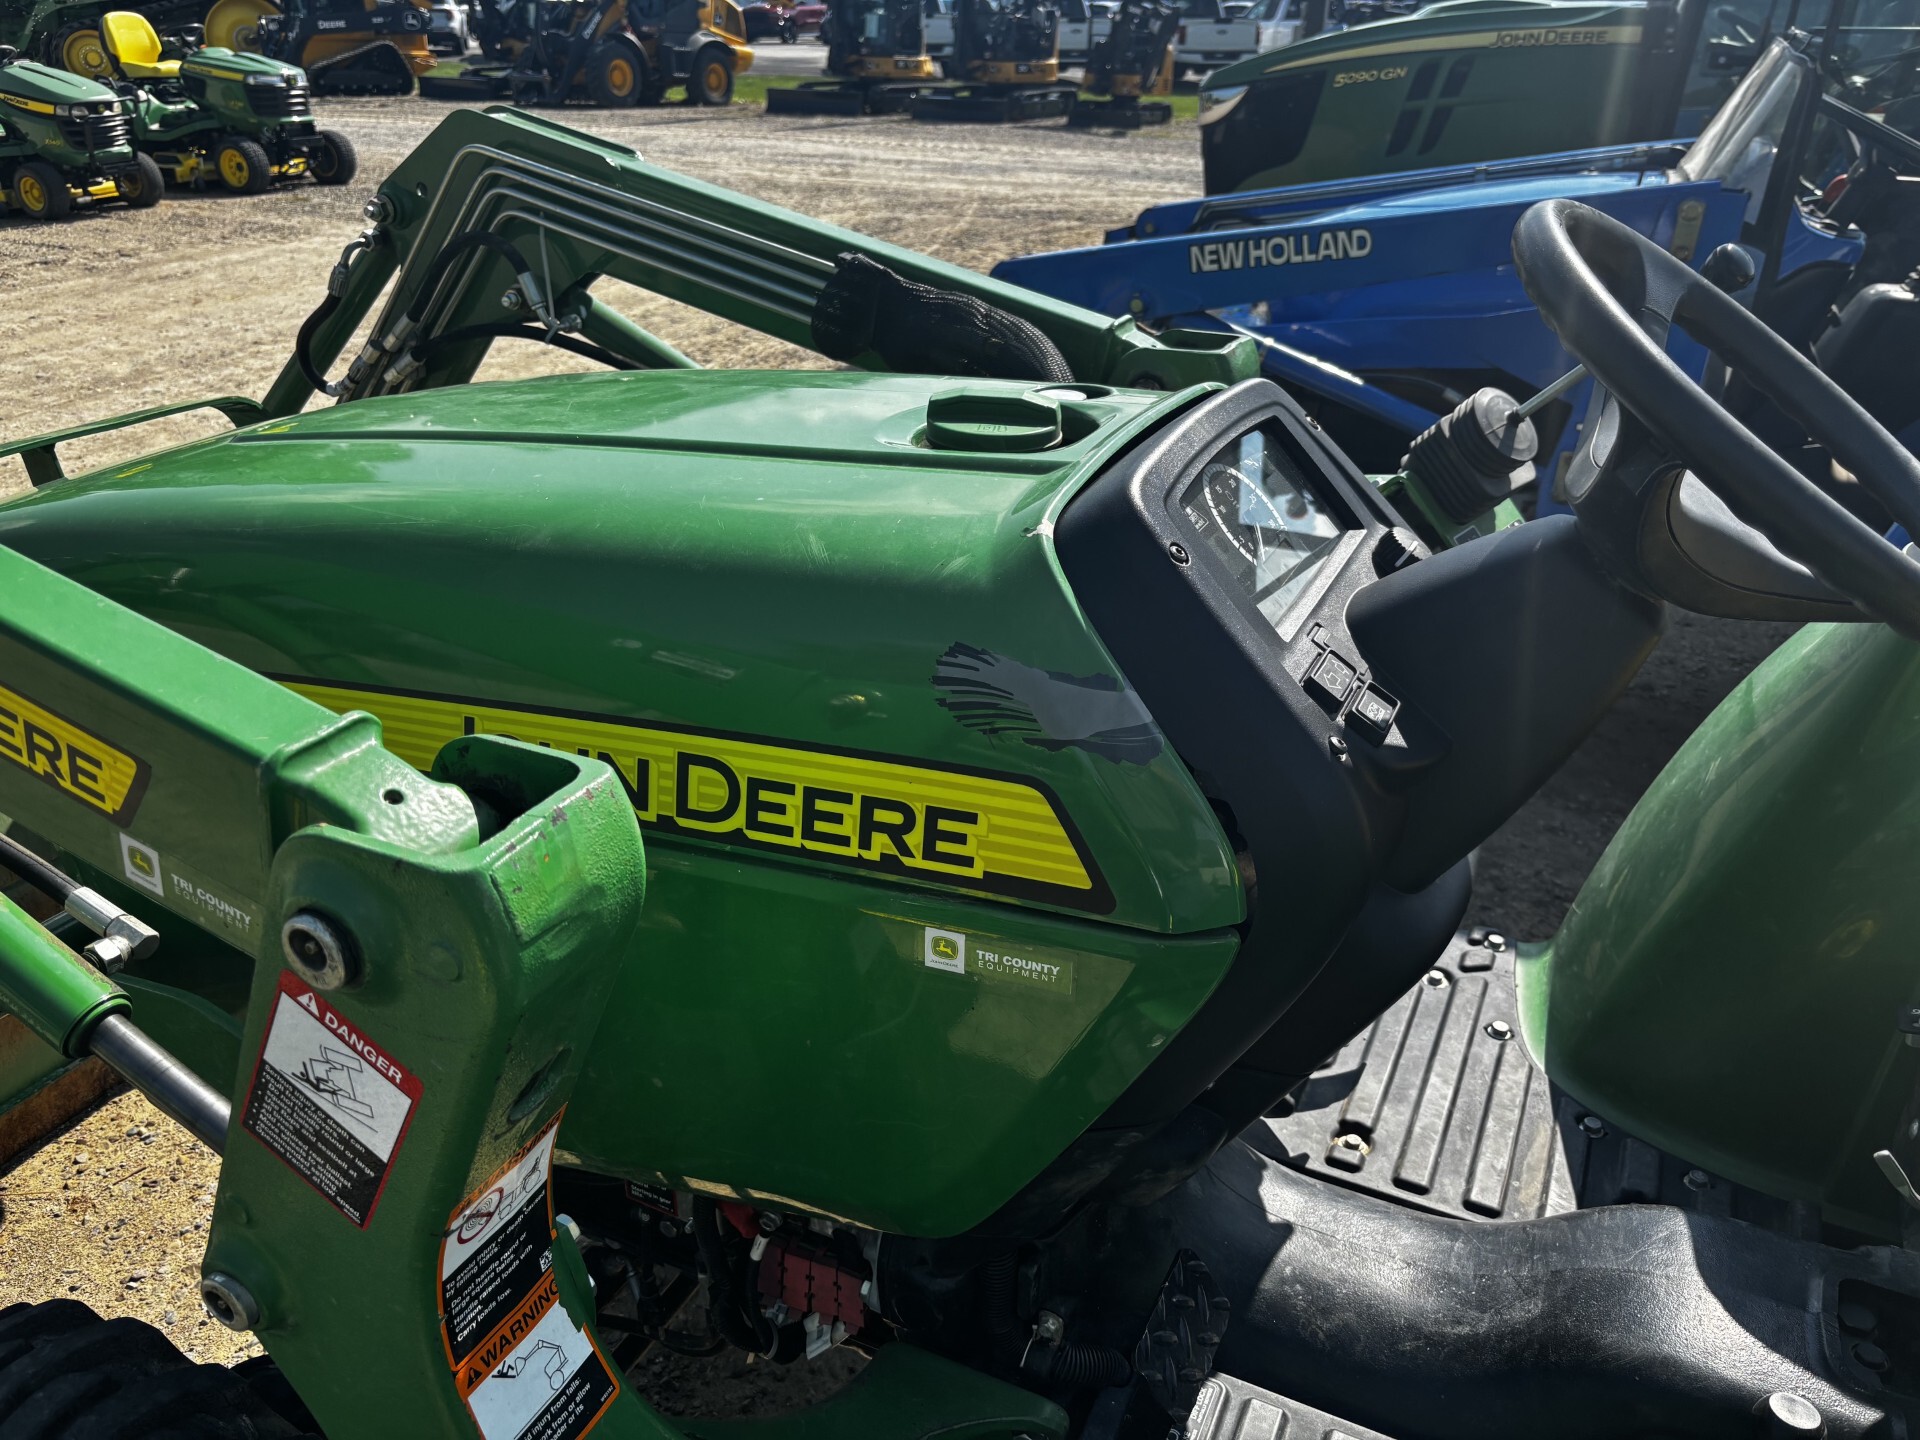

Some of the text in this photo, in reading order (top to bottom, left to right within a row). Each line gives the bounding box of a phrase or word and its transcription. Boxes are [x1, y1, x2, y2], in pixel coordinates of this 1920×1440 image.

[317, 19, 347, 30] DEERE
[1488, 29, 1609, 49] JOHN DEERE
[1332, 66, 1409, 88] 5090 GN
[1189, 228, 1373, 274] NEW HOLLAND
[675, 750, 980, 870] DEERE
[170, 873, 194, 894] TRI
[196, 888, 252, 925] COUNTY
[174, 886, 251, 934] EQUIPMENT
[976, 949, 1060, 975] TRI COUNTY
[978, 960, 1058, 983] EQUIPMENT
[324, 1011, 403, 1084] DANGER
[262, 1071, 286, 1092] result
[285, 1089, 304, 1109] from
[262, 1102, 273, 1113] all
[264, 1064, 366, 1153] Serious injury or death can
[266, 1090, 316, 1135] square bales.
[257, 1120, 310, 1167] recommended
[259, 1114, 343, 1188] Move wheels to widest
[260, 1109, 277, 1123] Add
[277, 1122, 309, 1151] required
[309, 1150, 325, 1165] rear
[264, 1095, 280, 1111] Use
[300, 1128, 317, 1143] and
[317, 1142, 349, 1170] seatbelt
[348, 1169, 358, 1178] at
[268, 1083, 375, 1178] Do not handle round or large
[255, 1125, 285, 1154] Operate
[286, 1151, 311, 1176] tractor
[311, 1174, 321, 1185] at
[320, 1182, 336, 1196] low
[336, 1195, 362, 1219] speed.
[446, 1188, 546, 1291] To avoid injury or death caused
[446, 1244, 502, 1300] by falling loads:
[451, 1231, 528, 1309] Do not handle round or
[452, 1252, 516, 1316] large square bales.
[453, 1244, 533, 1326] Handle raised loads with
[455, 1304, 484, 1333] caution.
[457, 1286, 513, 1342] Carry loads low.
[532, 1376, 582, 1436] injury from falls:
[551, 1410, 569, 1430] from
[568, 1399, 577, 1412] or
[576, 1382, 592, 1404] allow
[568, 1412, 576, 1424] or
[575, 1402, 585, 1416] its
